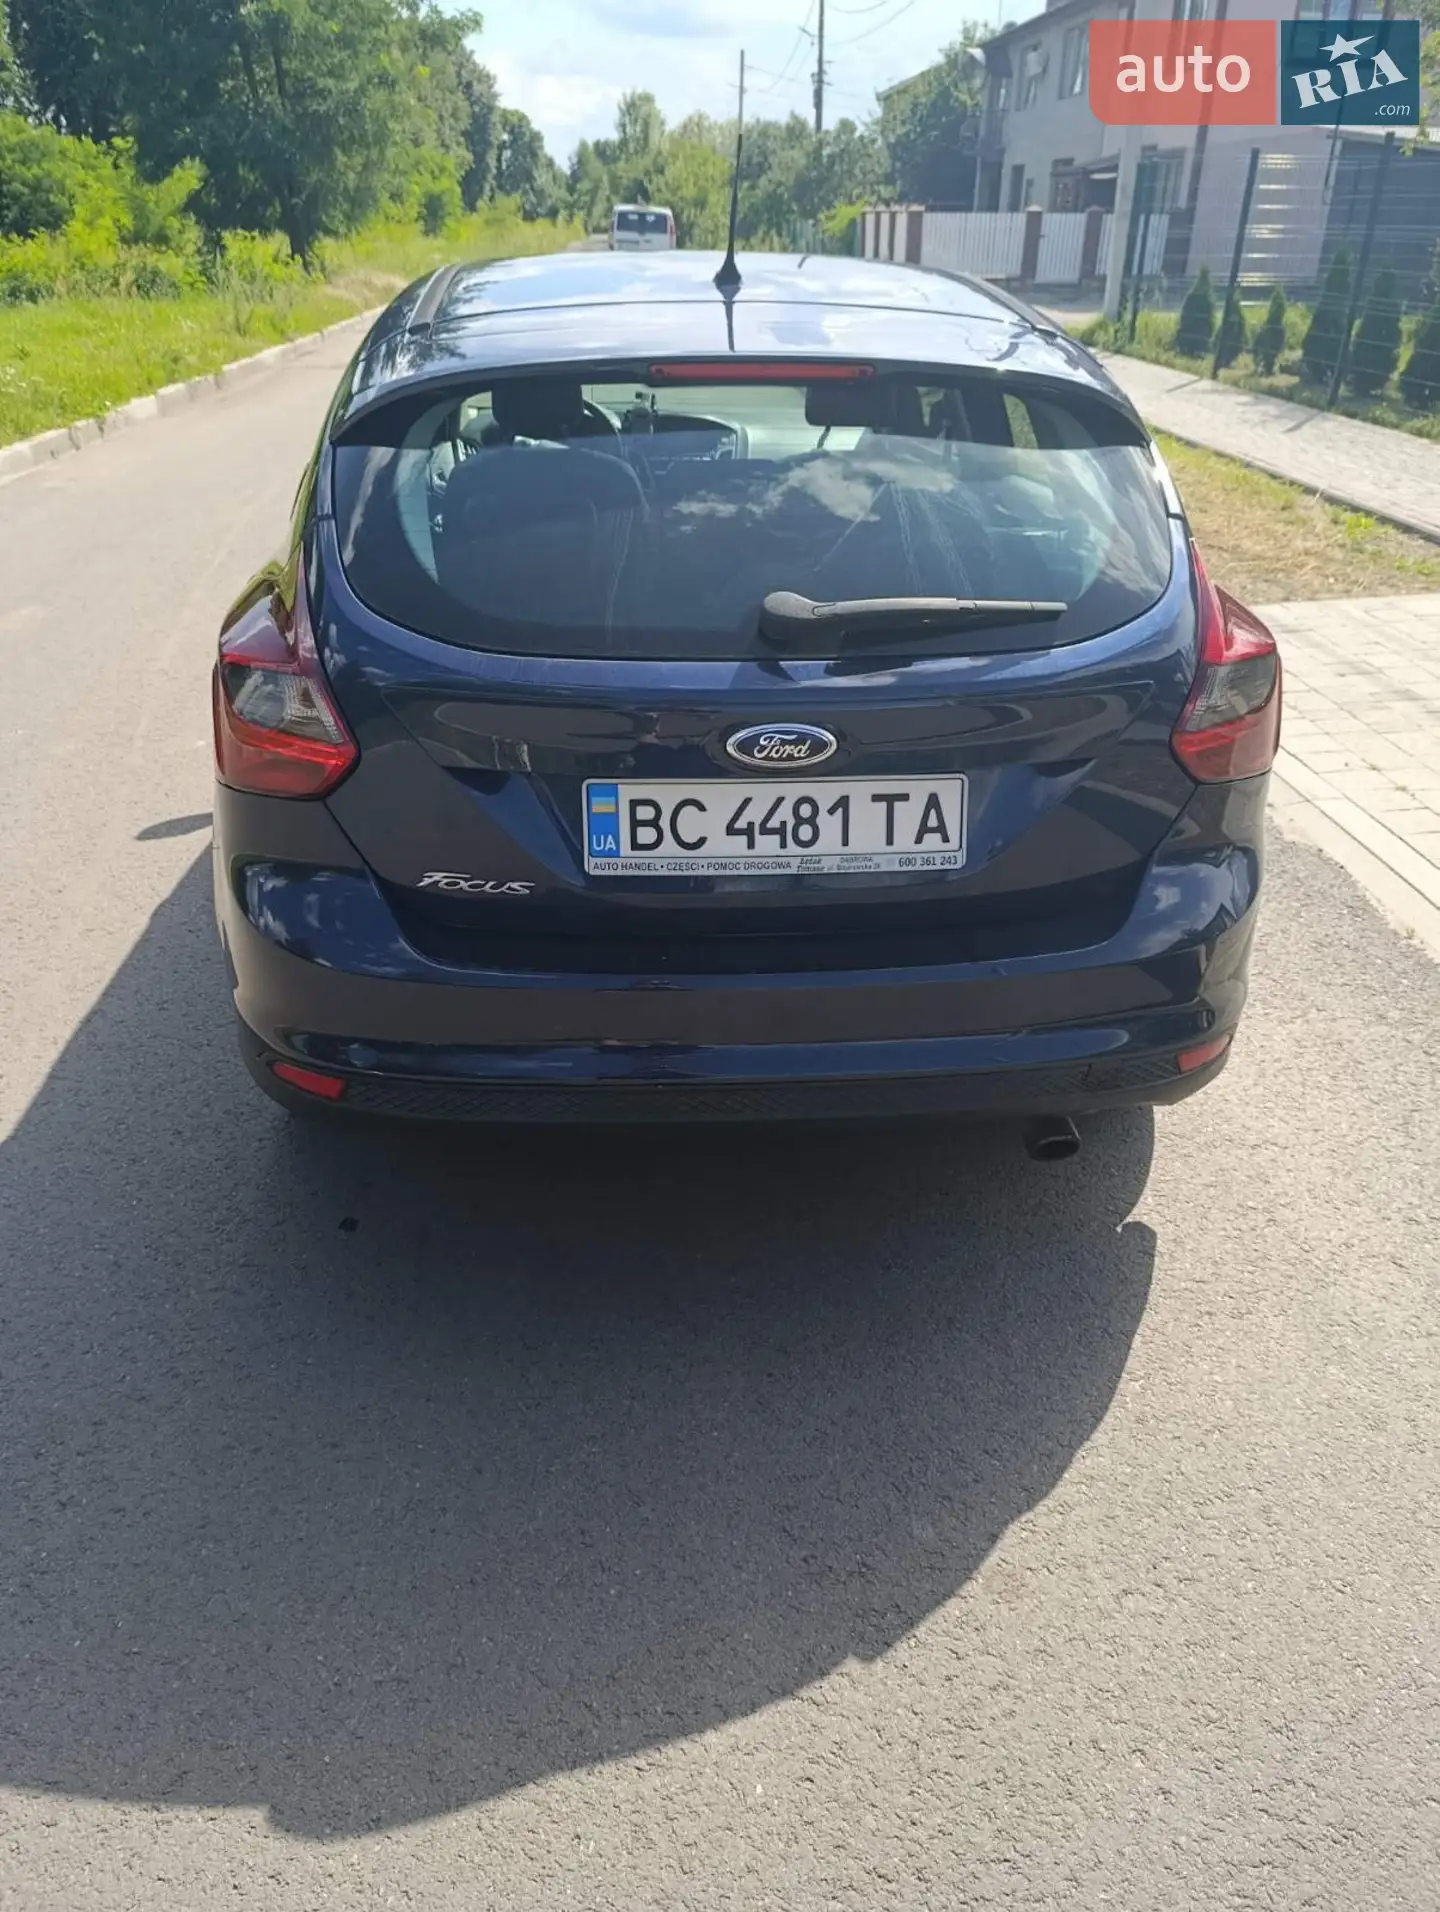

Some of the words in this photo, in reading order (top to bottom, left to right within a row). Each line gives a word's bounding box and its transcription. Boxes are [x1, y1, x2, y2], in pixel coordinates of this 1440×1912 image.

[753, 733, 812, 759] Ford
[629, 798, 708, 852] BC
[726, 795, 850, 850] 4481
[871, 792, 951, 847] TA
[592, 834, 617, 851] UA
[593, 861, 619, 872] AUTO
[621, 861, 659, 872] HANDEL
[706, 861, 741, 871] POMOC
[743, 860, 792, 871] DROGOWA
[898, 857, 917, 867] 600
[919, 856, 937, 866] 361
[940, 855, 958, 866] 243
